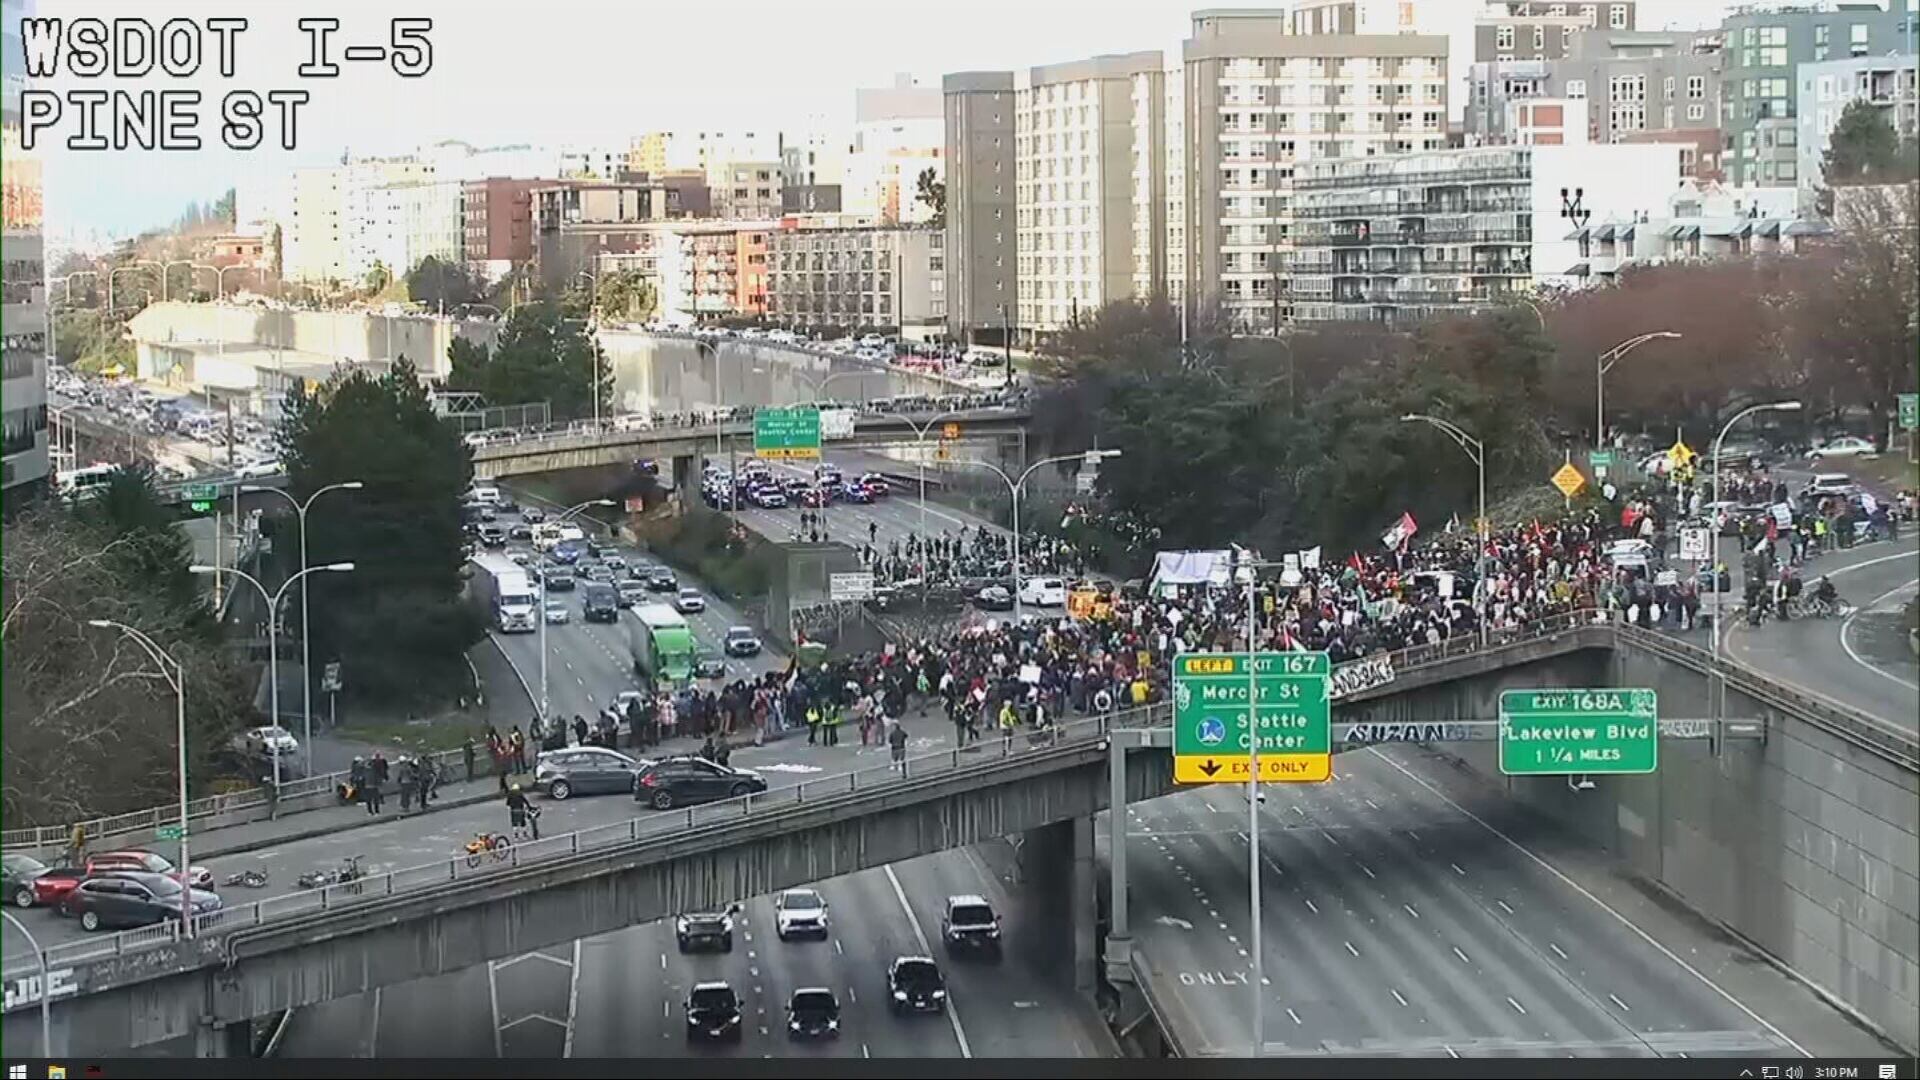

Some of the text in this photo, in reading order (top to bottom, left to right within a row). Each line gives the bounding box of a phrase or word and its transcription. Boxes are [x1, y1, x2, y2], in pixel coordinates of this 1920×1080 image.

[758, 428, 816, 436] Seattle Center
[1242, 659, 1272, 672] EXIT
[1283, 657, 1316, 672] 167
[1280, 683, 1300, 699] St
[1532, 693, 1623, 710] EXIT 168A
[1507, 725, 1596, 740] Lakeview
[1607, 724, 1648, 739] Blvd
[1238, 733, 1304, 748] Center
[1580, 749, 1621, 760] MILES
[1232, 762, 1308, 773] EXT ONLY
[1180, 972, 1248, 985] ONLY
